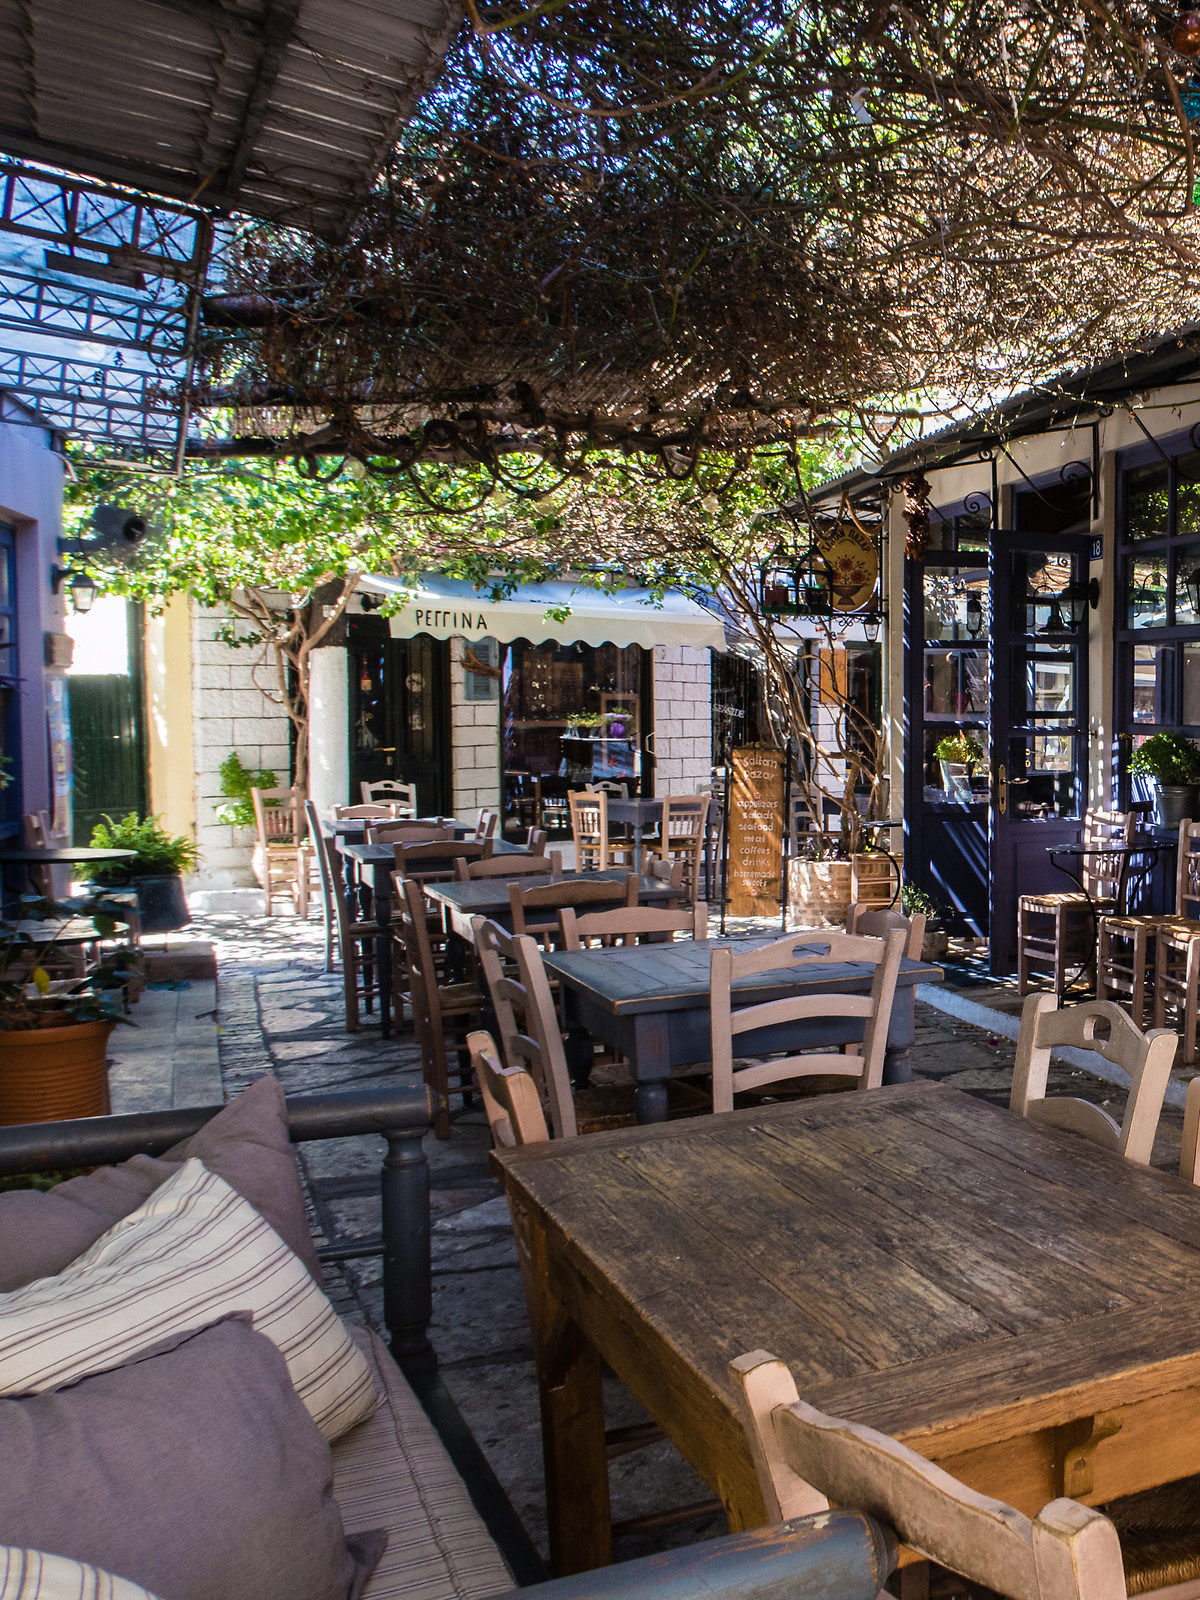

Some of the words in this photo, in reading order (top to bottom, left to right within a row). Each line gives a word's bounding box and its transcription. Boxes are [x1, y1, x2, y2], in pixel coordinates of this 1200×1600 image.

[1092, 540, 1101, 556] 18
[737, 800, 778, 810] appetizers
[743, 809, 774, 820] salads
[739, 821, 774, 831] seafood
[743, 835, 766, 843] meat
[739, 846, 771, 855] coffees
[733, 869, 776, 878] homemade
[741, 878, 768, 887] sweets
